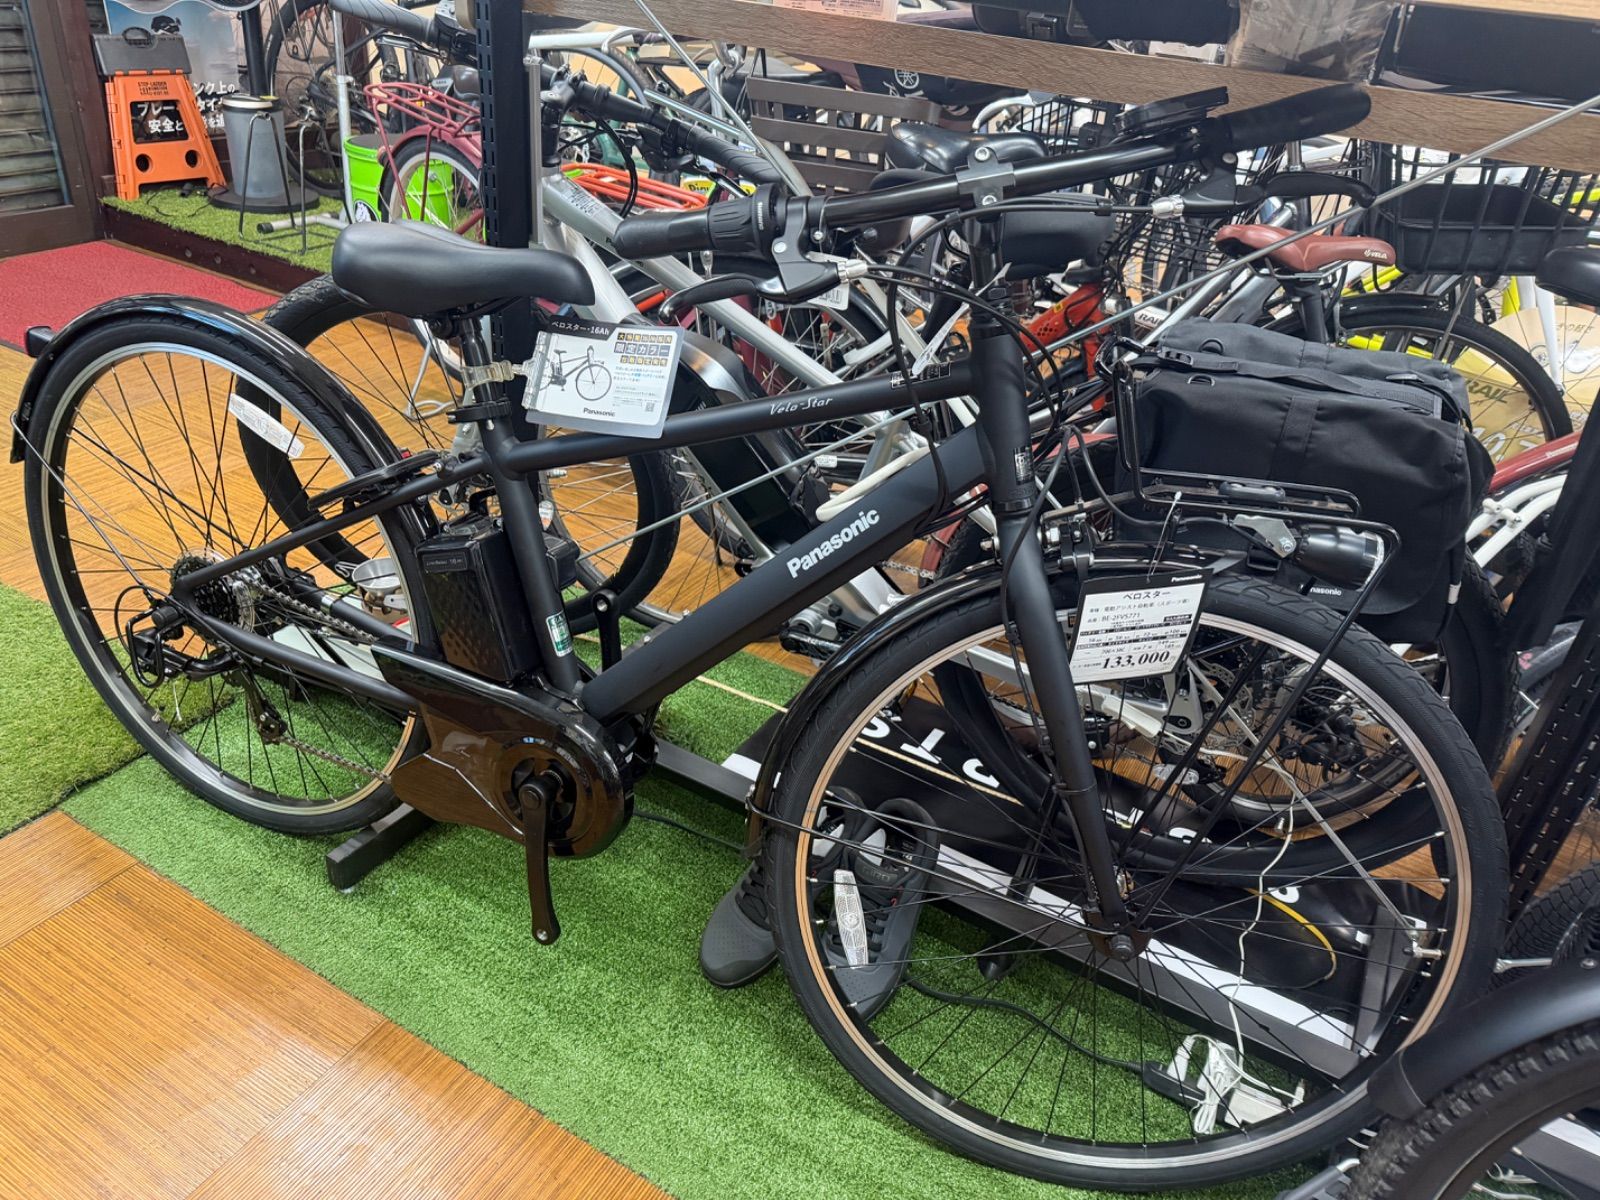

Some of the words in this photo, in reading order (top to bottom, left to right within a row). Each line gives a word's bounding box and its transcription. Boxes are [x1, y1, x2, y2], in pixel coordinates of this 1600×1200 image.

[148, 119, 185, 133] 安全と
[1138, 313, 1160, 325] RAI
[583, 407, 616, 417] Panasonic
[770, 397, 833, 415] Velo-Star
[786, 508, 880, 579] Panasonic
[1123, 590, 1171, 600] ベロスター
[1301, 584, 1342, 596] nasonic
[1101, 651, 1170, 669] 133,000
